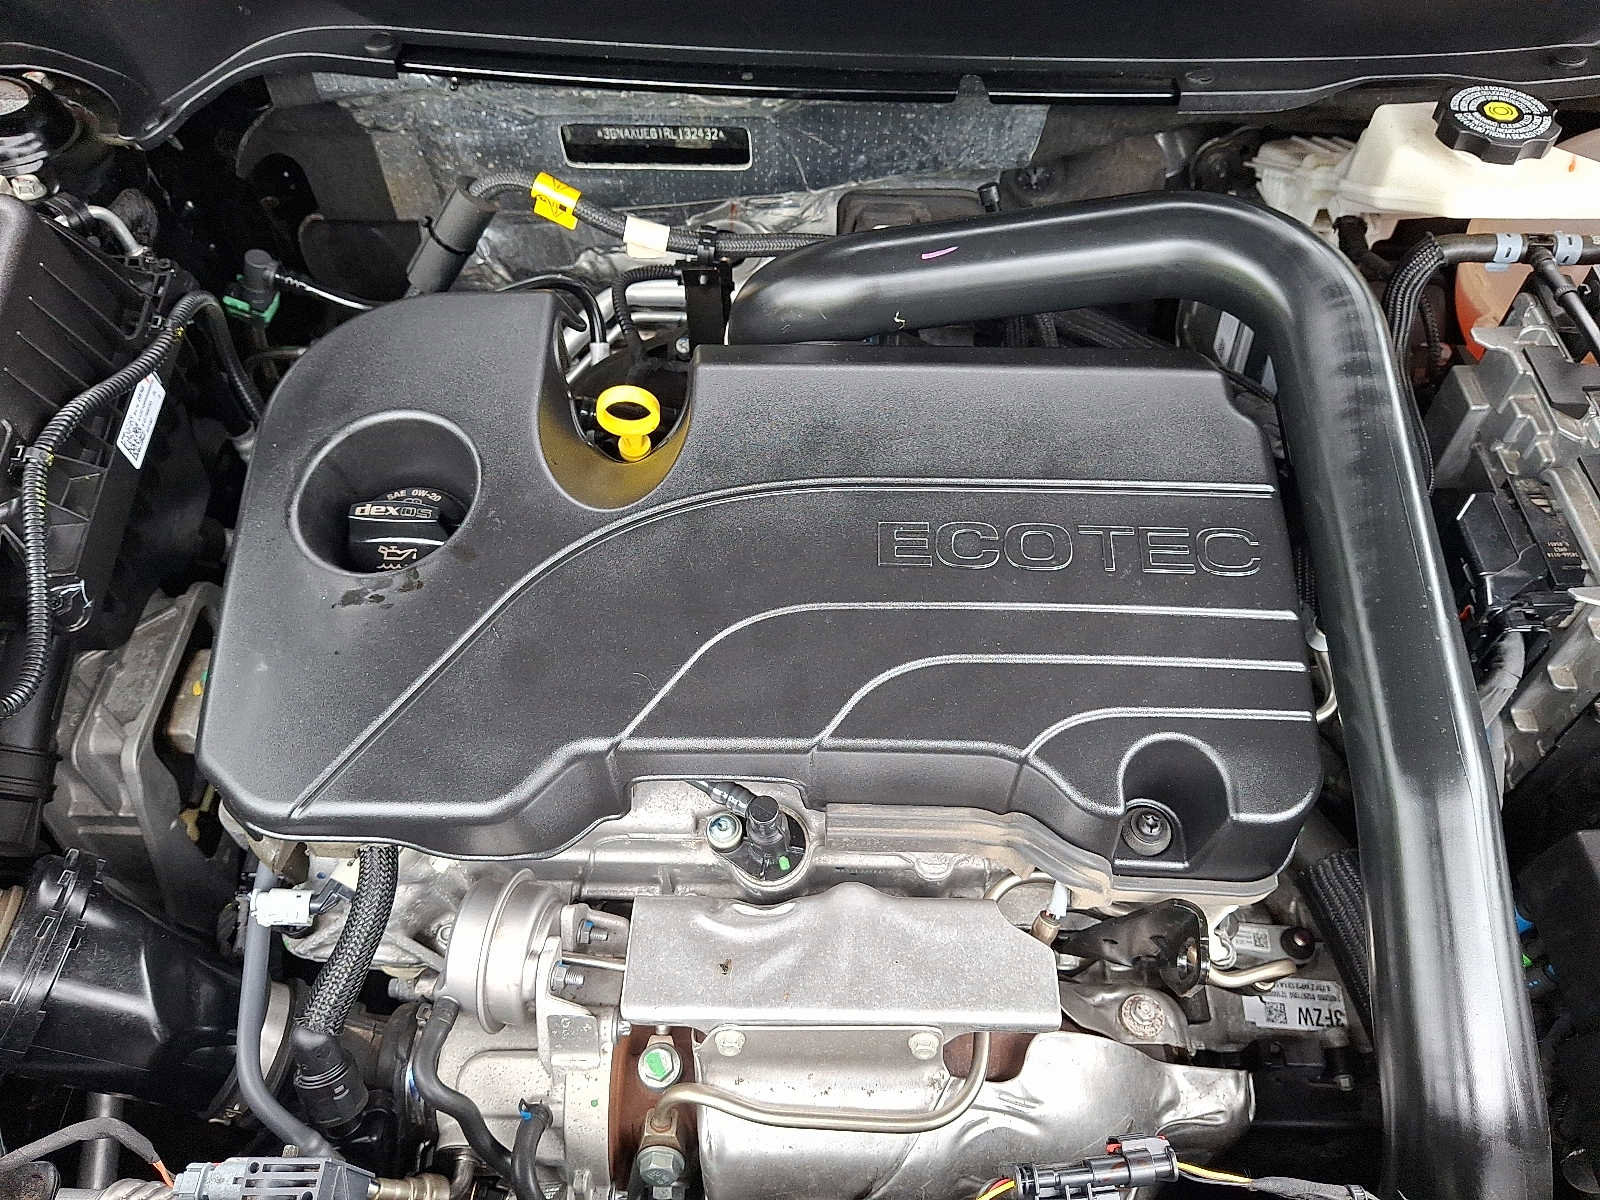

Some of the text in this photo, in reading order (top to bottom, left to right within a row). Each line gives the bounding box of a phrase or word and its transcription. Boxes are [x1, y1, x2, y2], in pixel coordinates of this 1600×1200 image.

[387, 489, 442, 502] SAE 0W-20
[354, 503, 433, 519] dexos
[877, 521, 1262, 577] ECOTEC
